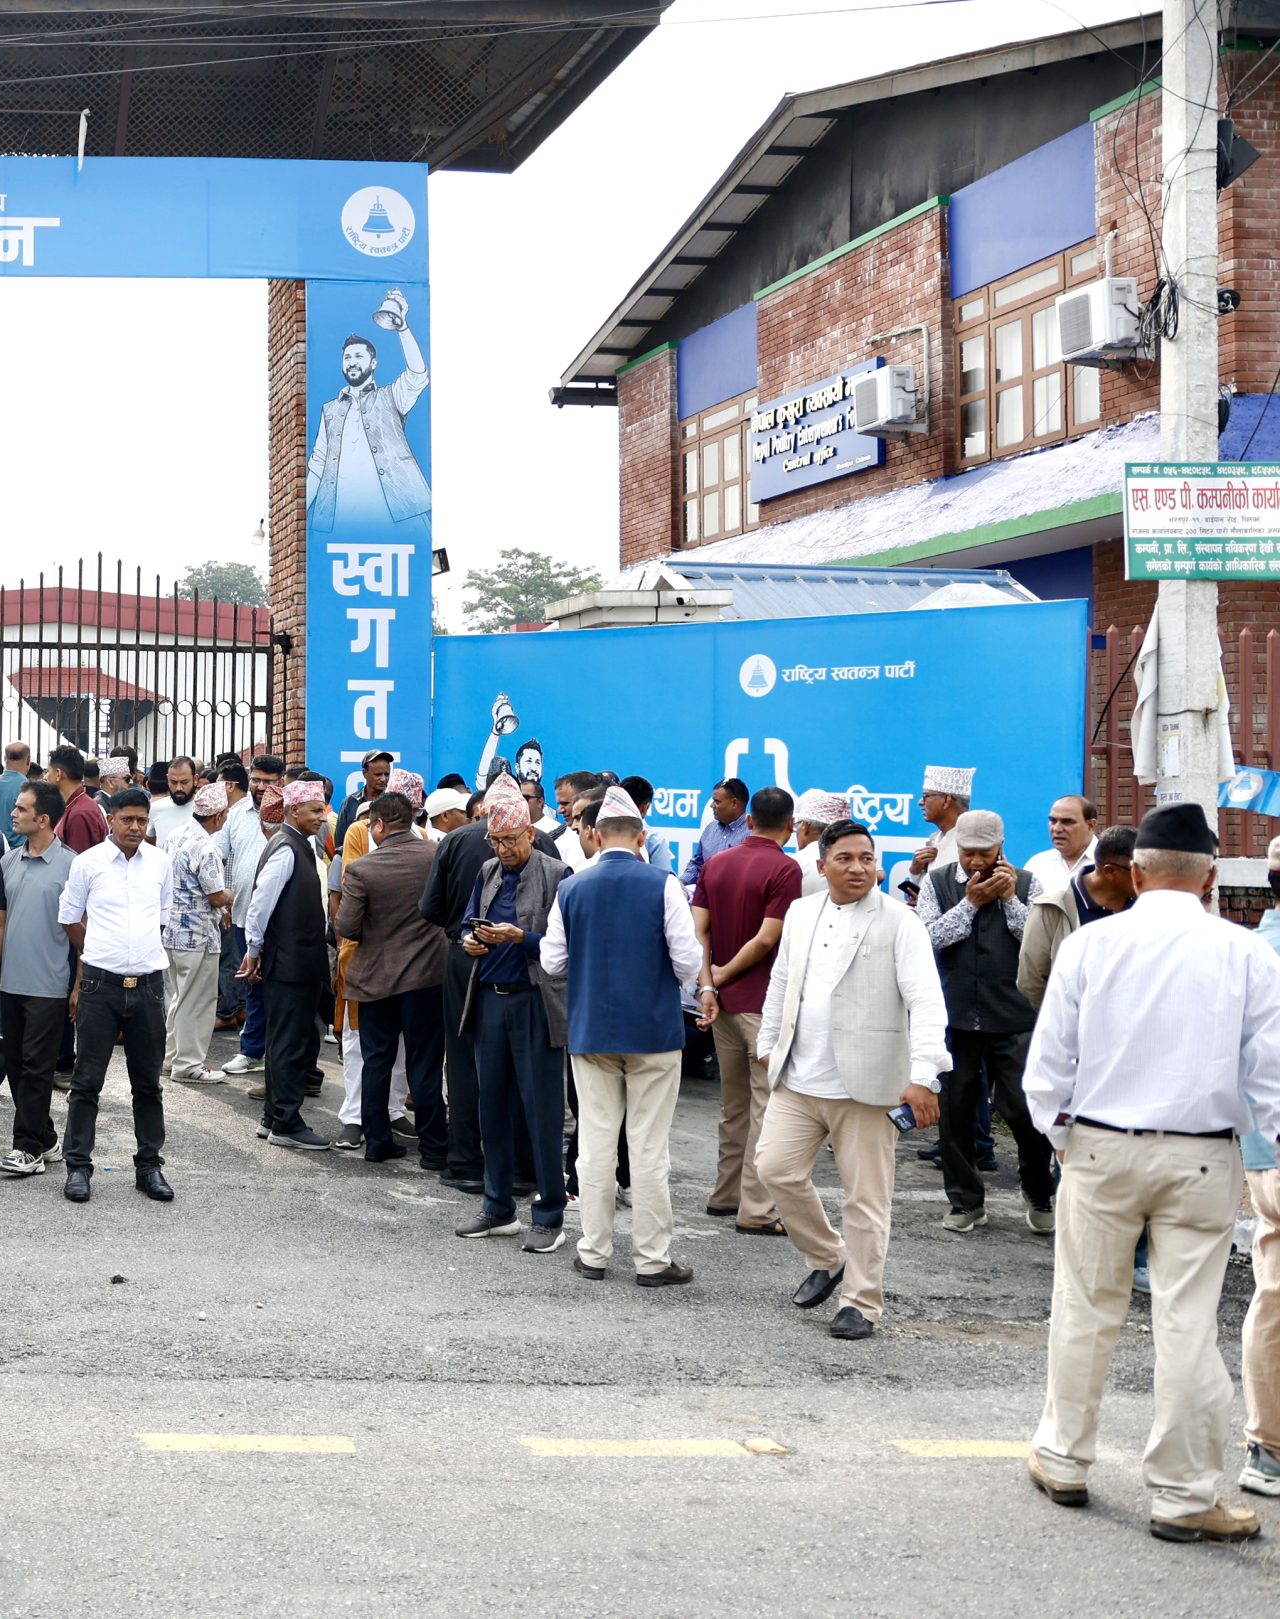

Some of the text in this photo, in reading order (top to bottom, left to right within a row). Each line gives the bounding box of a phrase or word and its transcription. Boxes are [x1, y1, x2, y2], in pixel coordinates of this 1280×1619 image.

[752, 437, 770, 464] Nepal
[771, 431, 795, 454] Poultry
[782, 451, 811, 472] Central
[813, 445, 835, 465] office
[1131, 480, 1280, 512] एस. एण्ड पी. कम्पनीको कार्या
[781, 660, 916, 684] राष्ट्रिय स्वतन्त्र पार्टी
[647, 785, 913, 831] थम ष्ट्रिय
